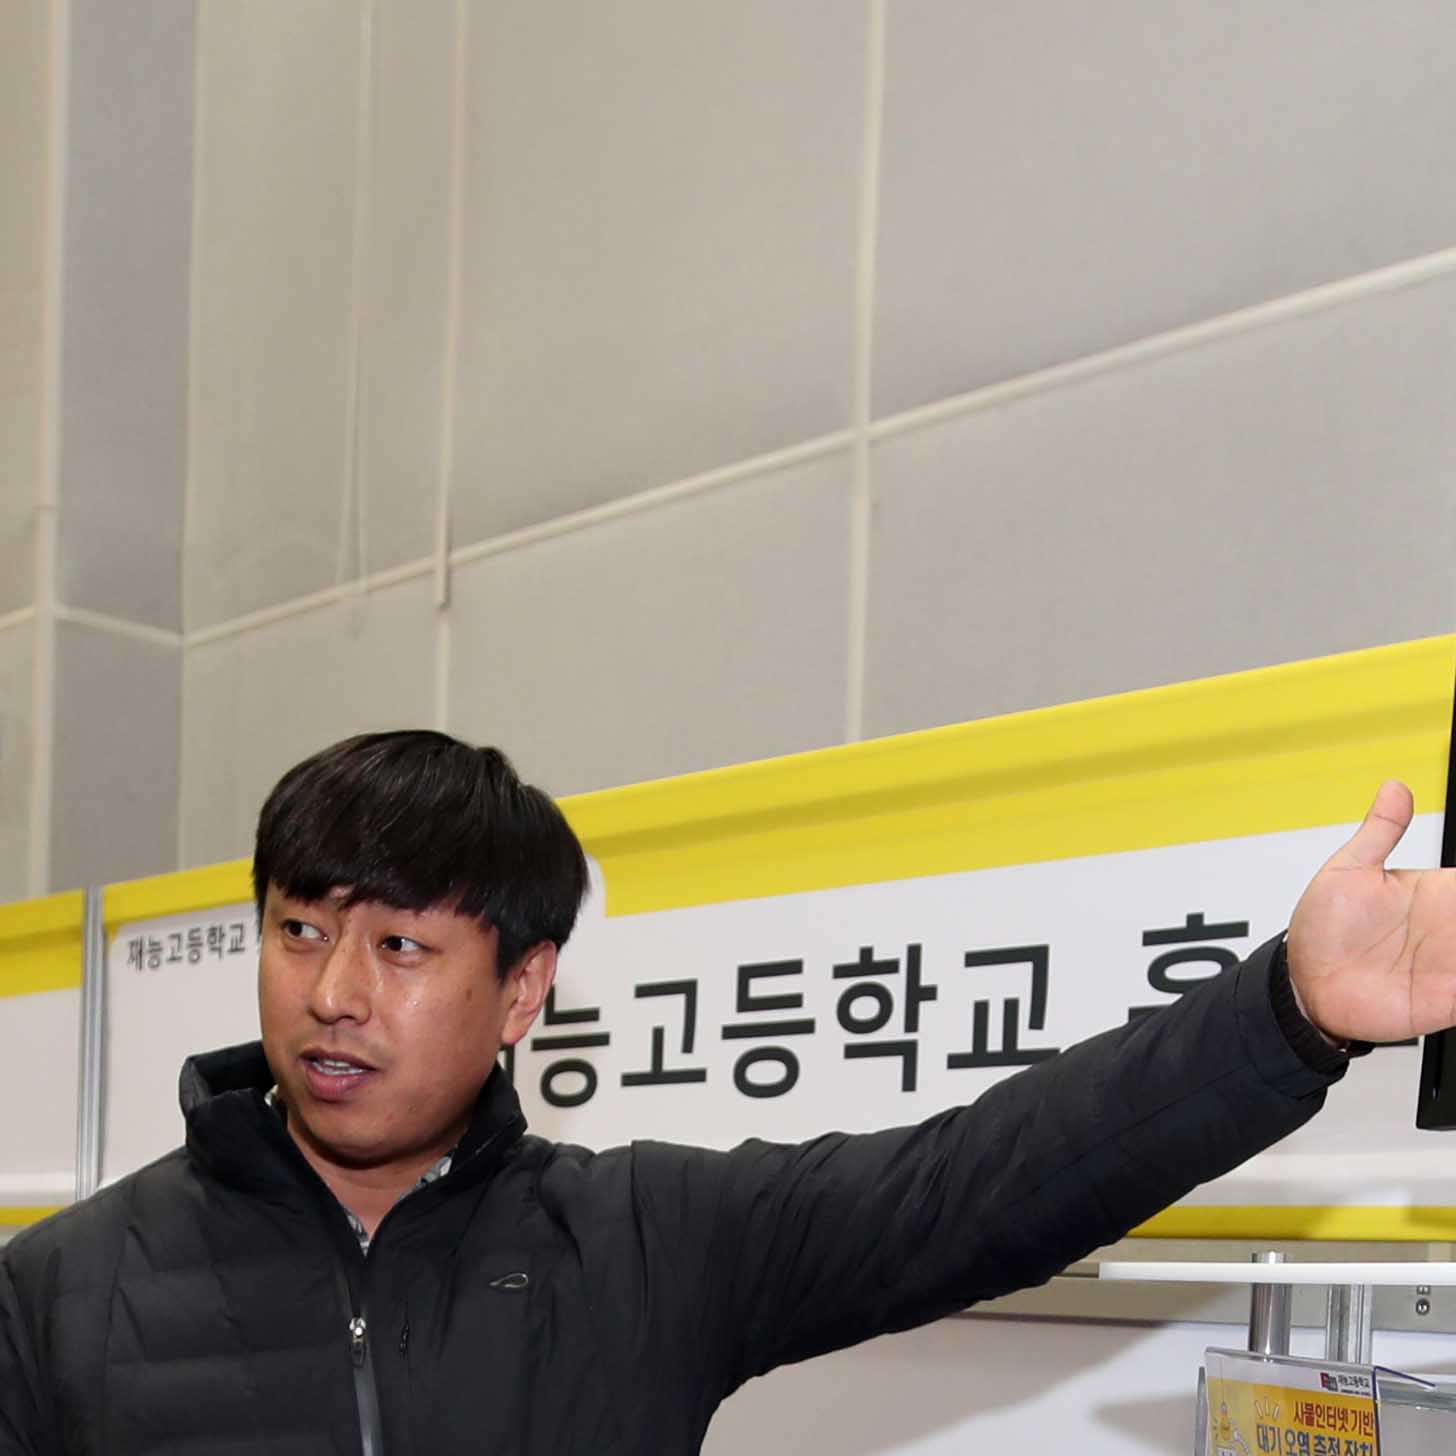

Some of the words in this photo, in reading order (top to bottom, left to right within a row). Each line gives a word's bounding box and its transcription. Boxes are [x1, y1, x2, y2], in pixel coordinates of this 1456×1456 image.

[126, 920, 247, 972] 재능고등학교
[504, 942, 1062, 1109] 능고등학교
[1256, 1423, 1282, 1456] 대기
[1294, 1400, 1349, 1433] 사물인터넷
[1350, 1406, 1374, 1437] 기반
